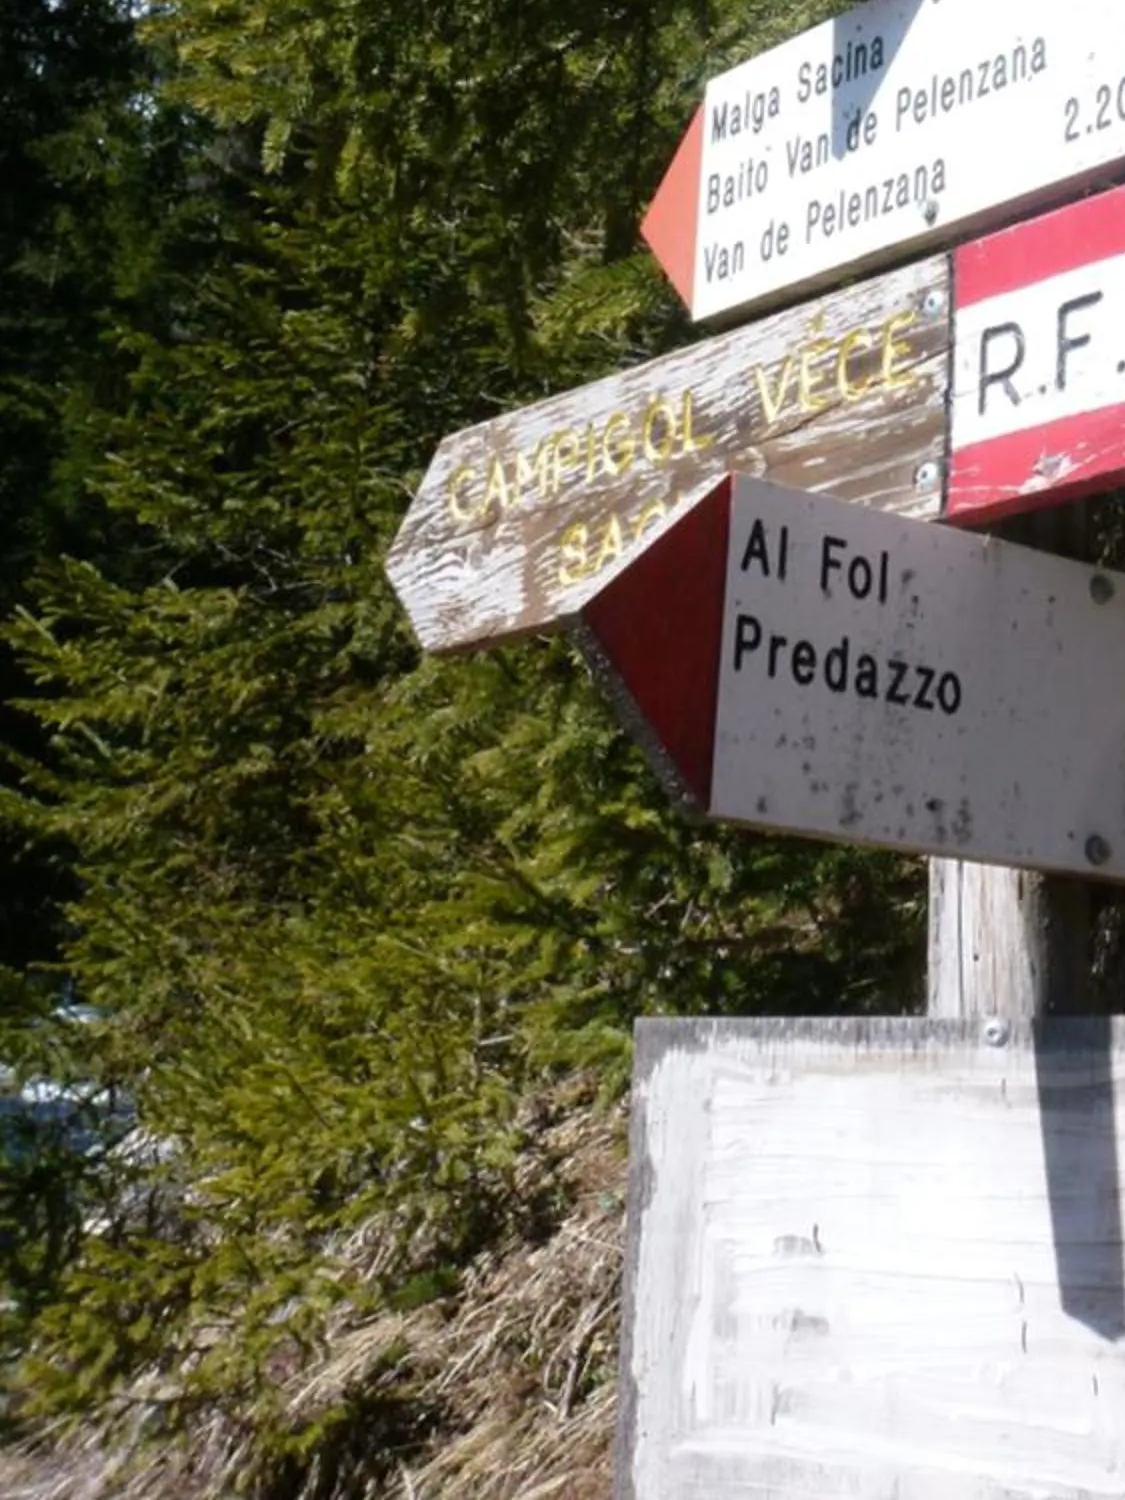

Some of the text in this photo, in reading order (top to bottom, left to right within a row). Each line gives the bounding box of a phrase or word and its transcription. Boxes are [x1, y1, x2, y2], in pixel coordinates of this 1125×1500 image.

[710, 35, 885, 145] Malga Sacina
[785, 132, 830, 179] Van
[845, 107, 878, 153] de
[894, 36, 1048, 134] Pelenzana
[702, 157, 947, 284] Van de Pelenzana
[740, 518, 890, 605] Al Fol
[732, 613, 962, 715] Predazzo
